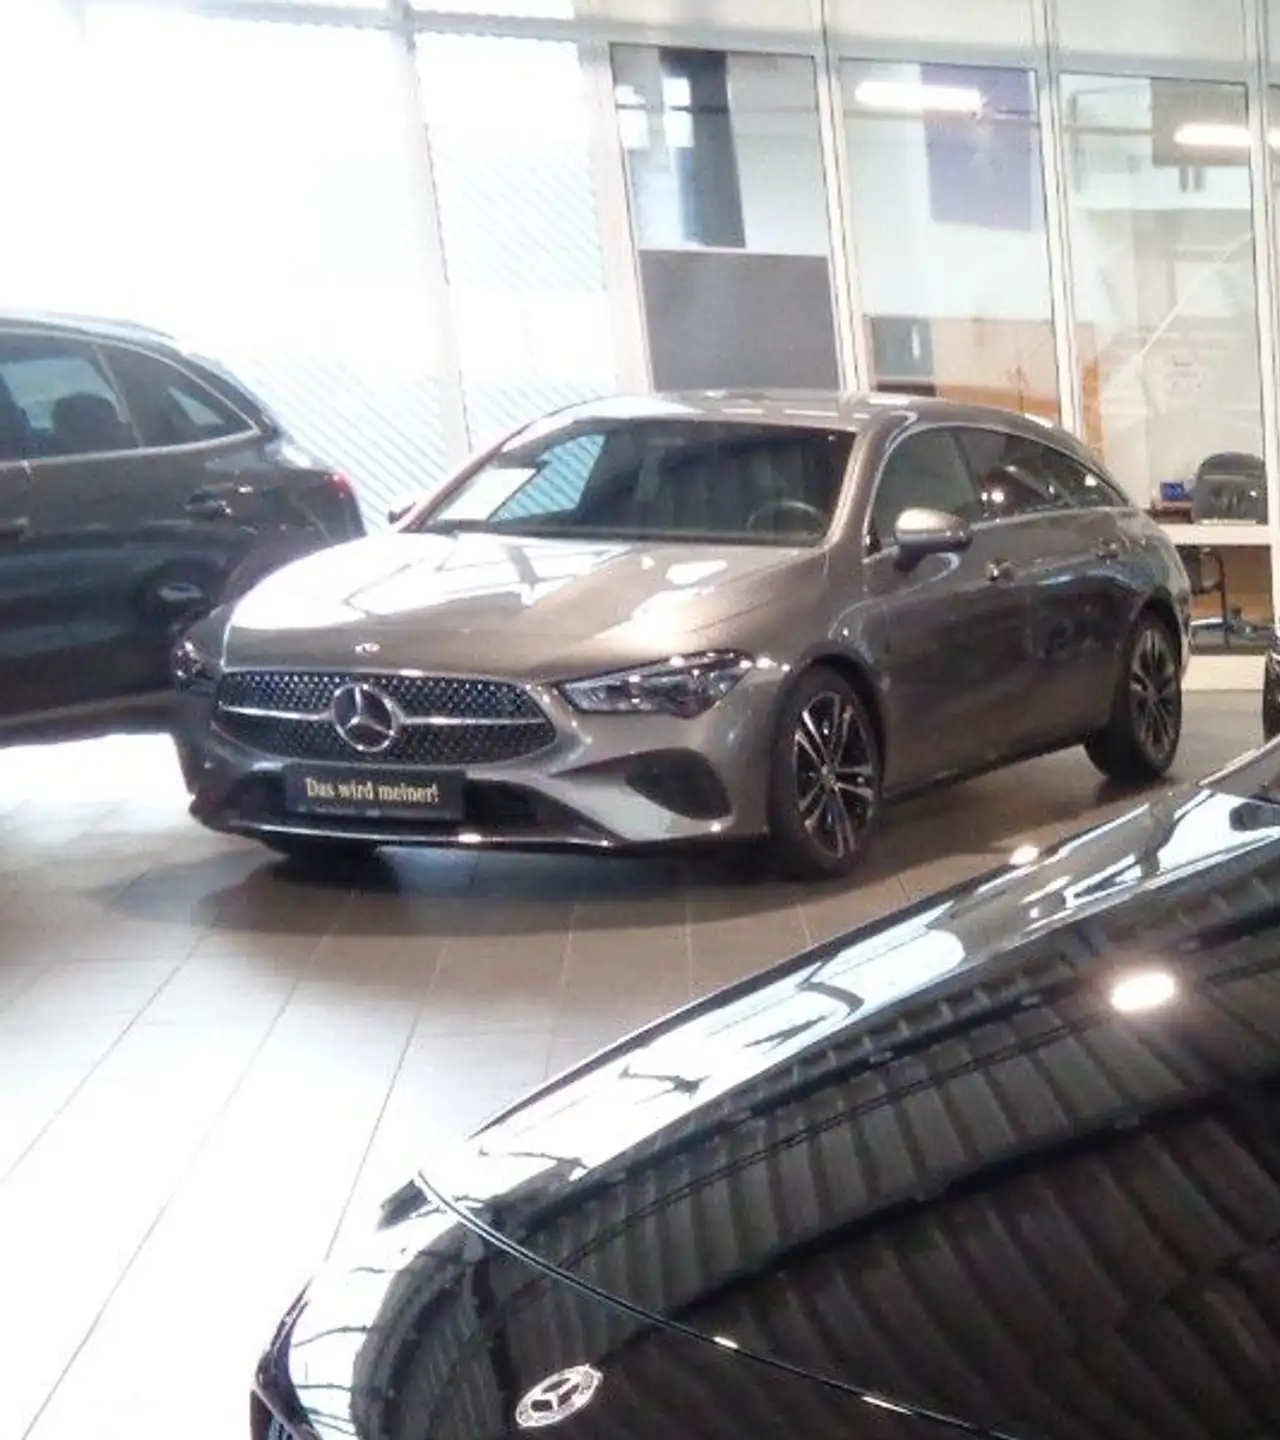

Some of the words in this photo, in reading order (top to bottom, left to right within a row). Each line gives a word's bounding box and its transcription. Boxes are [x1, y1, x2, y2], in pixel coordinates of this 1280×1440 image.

[304, 776, 335, 798] Das
[338, 780, 374, 801] wird
[379, 783, 439, 804] meiner!
